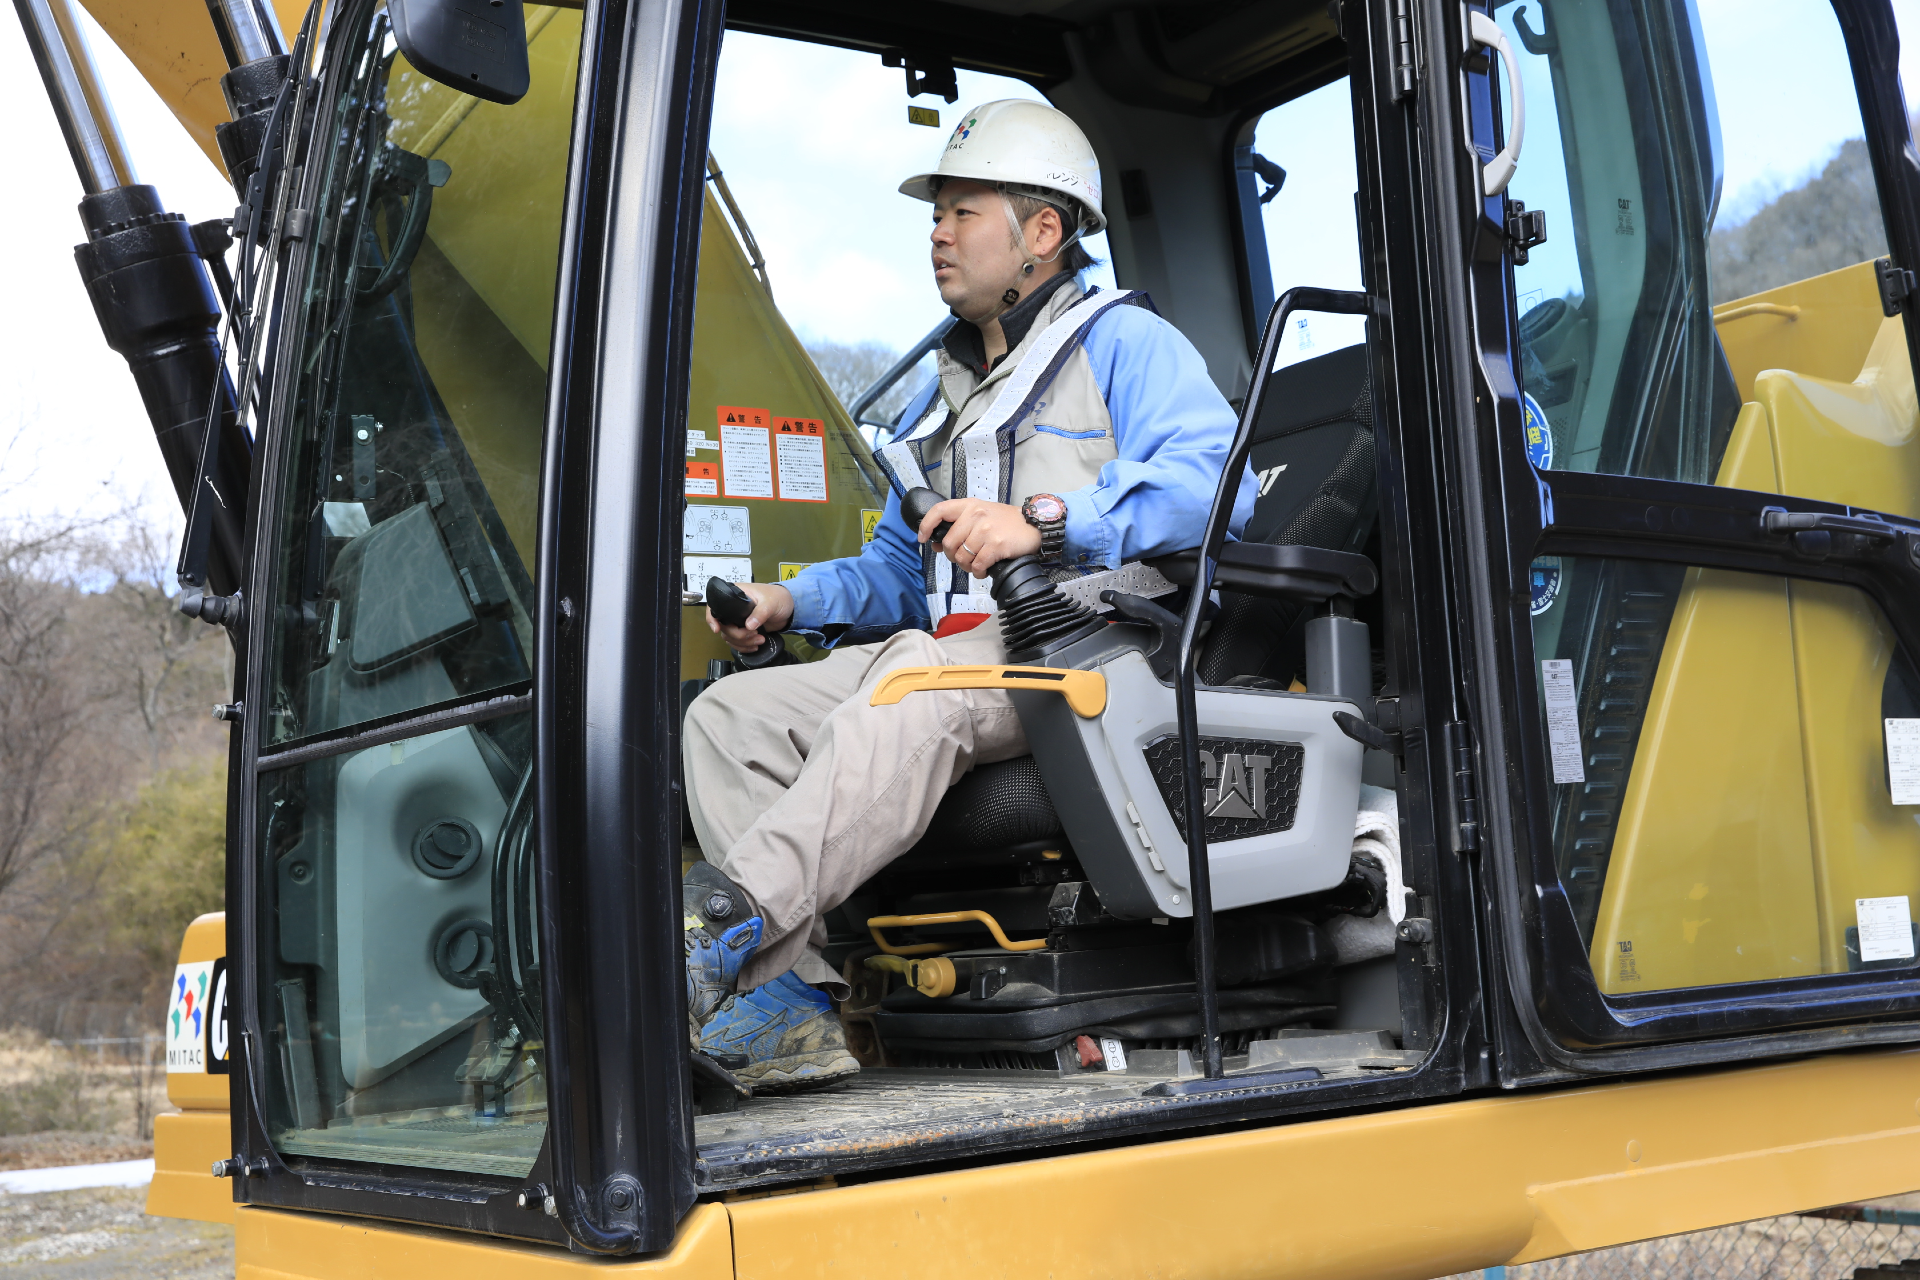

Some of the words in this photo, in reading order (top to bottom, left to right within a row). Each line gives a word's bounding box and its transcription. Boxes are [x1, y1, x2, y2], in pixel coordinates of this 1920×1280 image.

[794, 421, 818, 434] 警告
[1257, 463, 1288, 499] AT
[1533, 571, 1545, 588] 車
[169, 1049, 202, 1065] MITAC
